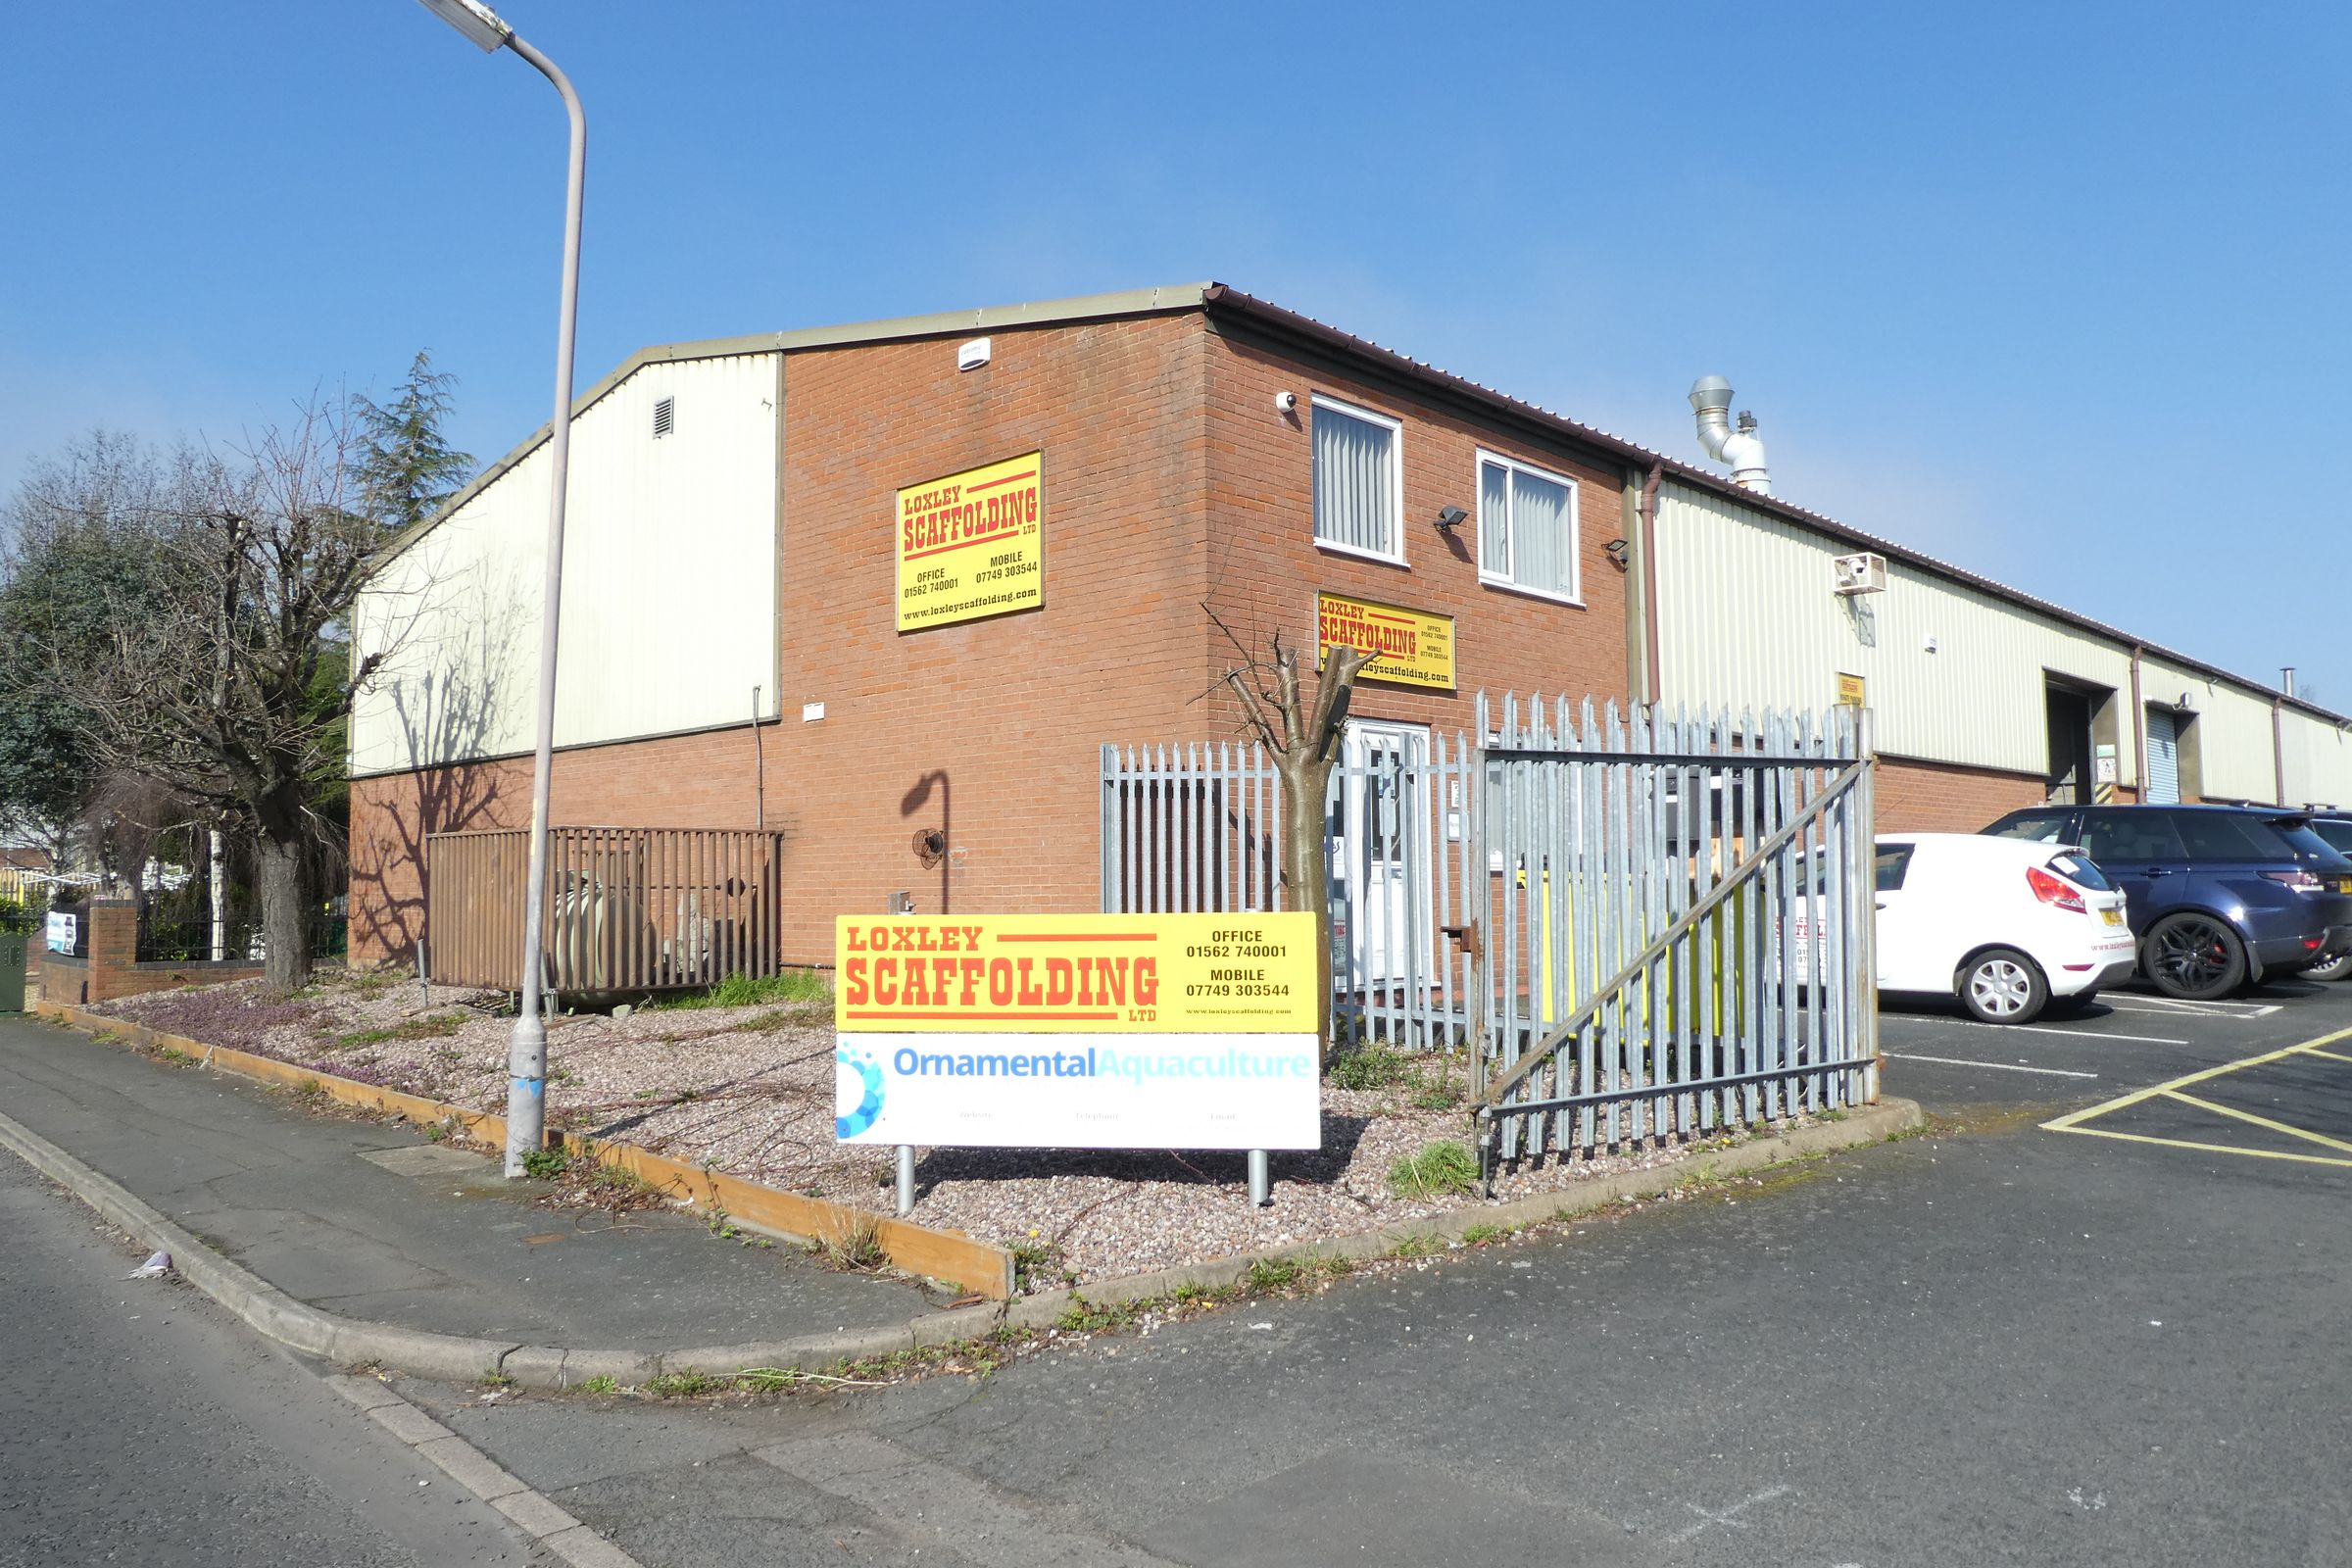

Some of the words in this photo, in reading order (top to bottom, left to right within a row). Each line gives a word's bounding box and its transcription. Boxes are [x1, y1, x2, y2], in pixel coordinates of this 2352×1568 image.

[905, 485, 961, 515] LOXLEY
[905, 486, 1037, 552] SCAFFOLDING
[1023, 523, 1036, 535] LTD
[990, 551, 1023, 567] MOBILE
[917, 568, 946, 582] OFFICE
[976, 568, 1003, 583] 07749
[1004, 562, 1037, 578] 303544
[905, 584, 927, 598] 01562
[930, 578, 958, 596] 740001
[904, 588, 1037, 620] www.loxleyscaffolding.com
[1320, 599, 1365, 619] LOXLEY
[1320, 615, 1416, 655] SCAFFOLDING
[847, 926, 983, 952] LOXLEY
[1211, 930, 1262, 943] OFFICE
[1186, 946, 1230, 957] 01562
[1235, 946, 1287, 957] 740001
[846, 956, 1159, 1006] SCAFFOLDING
[1210, 969, 1265, 981] MOBILE
[1186, 984, 1230, 997] 07749
[1235, 984, 1290, 997] 303544
[1129, 1009, 1156, 1022] LTD
